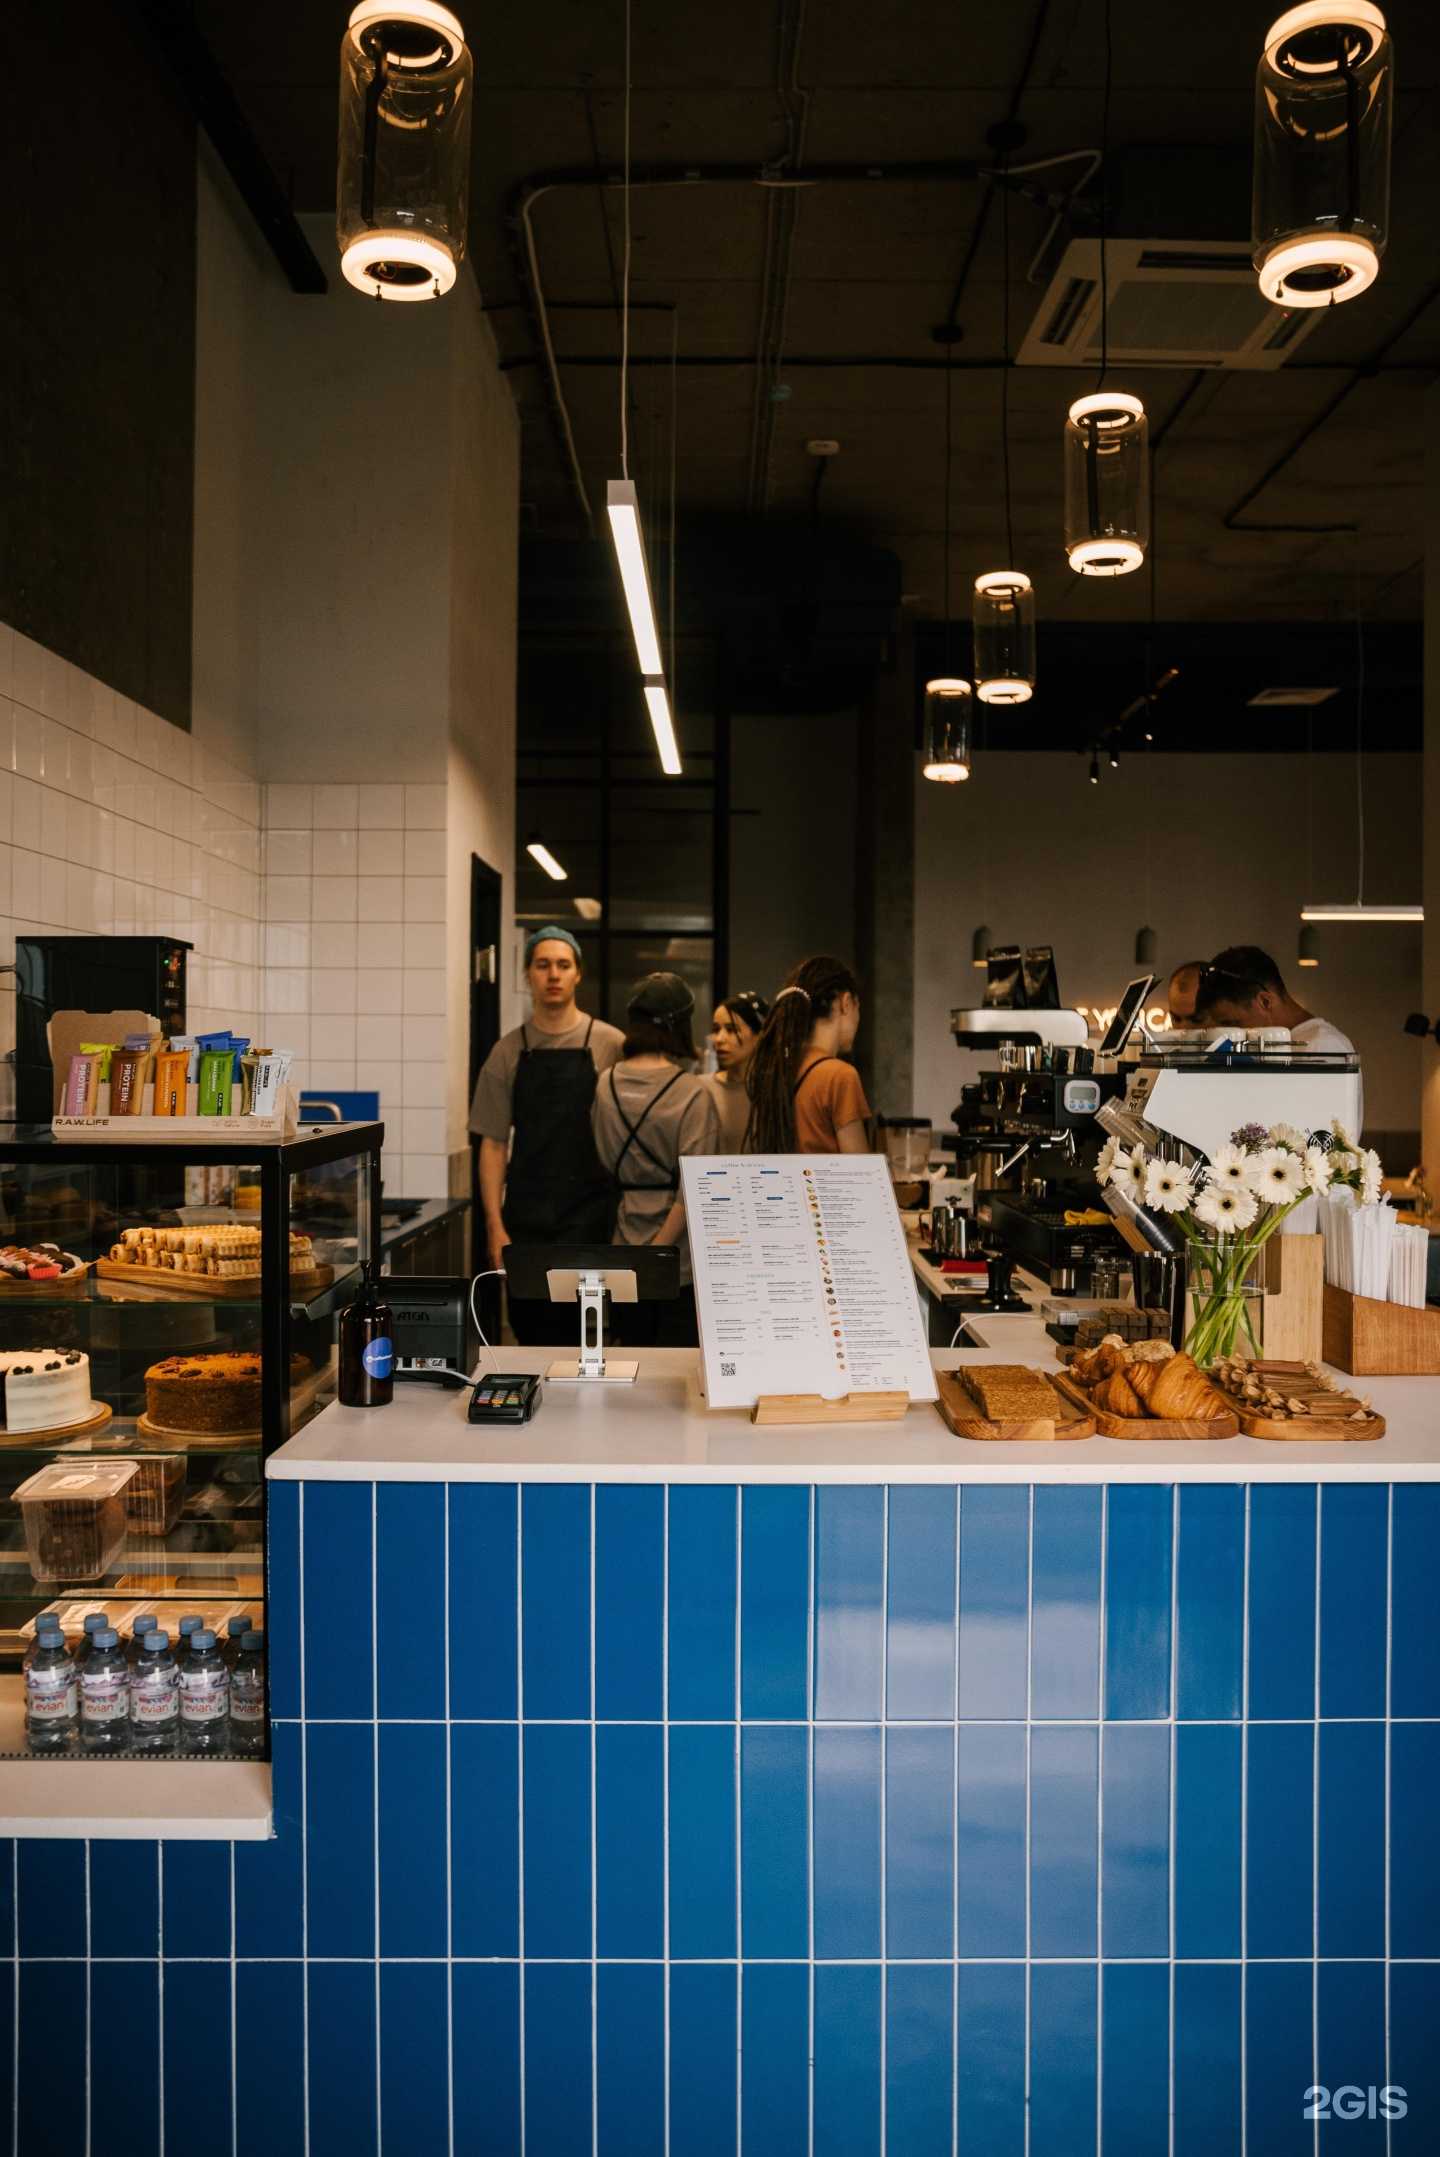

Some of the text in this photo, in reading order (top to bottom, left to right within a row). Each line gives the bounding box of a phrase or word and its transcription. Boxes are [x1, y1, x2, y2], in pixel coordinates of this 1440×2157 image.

[120, 1063, 132, 1103] PROTEIN
[35, 1702, 64, 1712] evian
[86, 1703, 113, 1713] evian
[140, 1702, 169, 1713] evian
[185, 1702, 211, 1713] evian
[234, 1703, 260, 1713] evian
